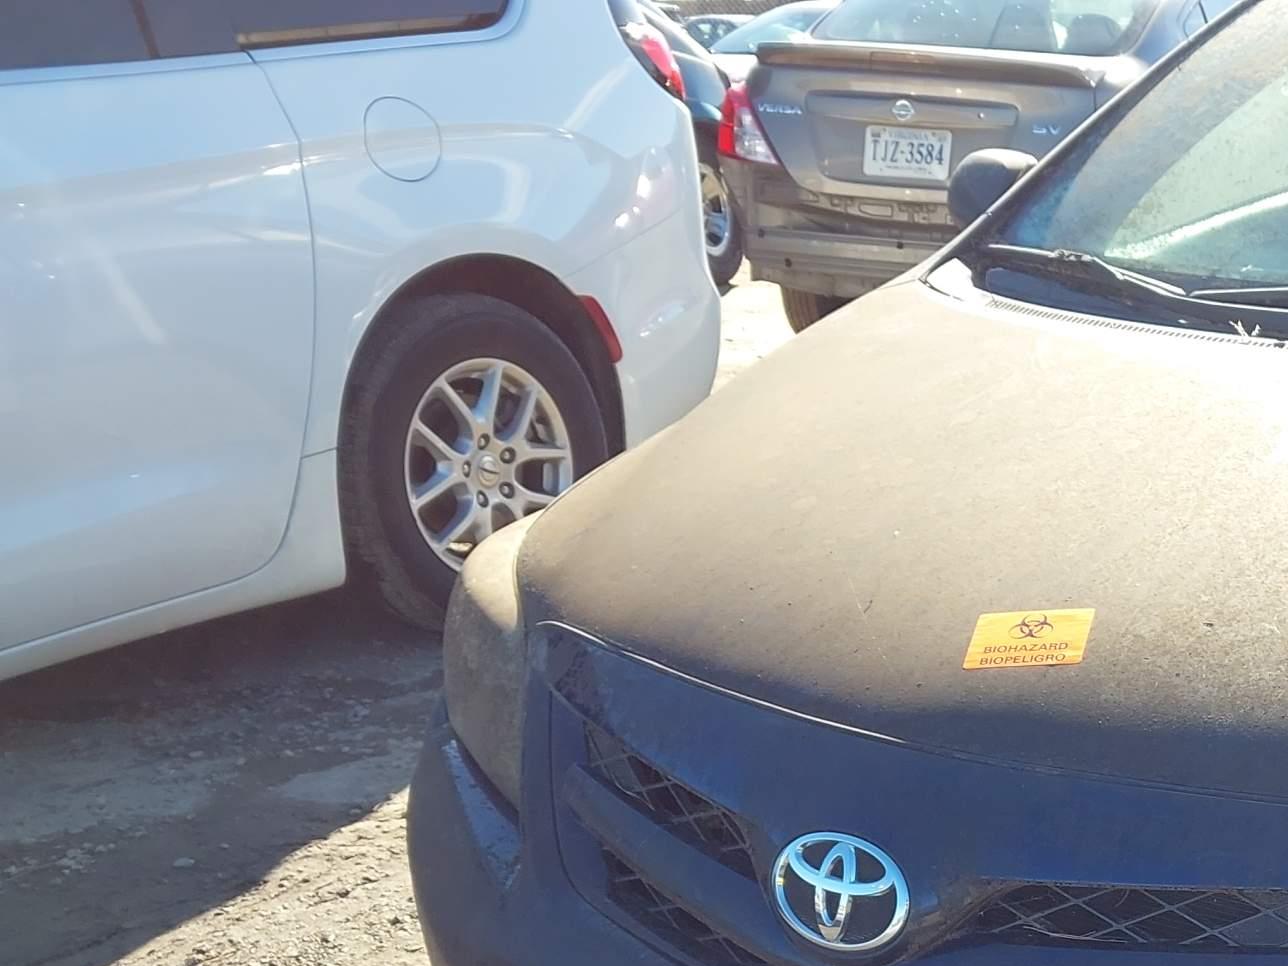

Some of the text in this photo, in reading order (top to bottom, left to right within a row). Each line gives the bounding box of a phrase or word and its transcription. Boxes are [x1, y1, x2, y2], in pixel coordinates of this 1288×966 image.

[758, 103, 803, 115] VERSA
[872, 139, 944, 165] TJZ-3584
[983, 642, 1069, 654] BIOHAZARD
[979, 653, 1066, 665] BIOPELIGRO
